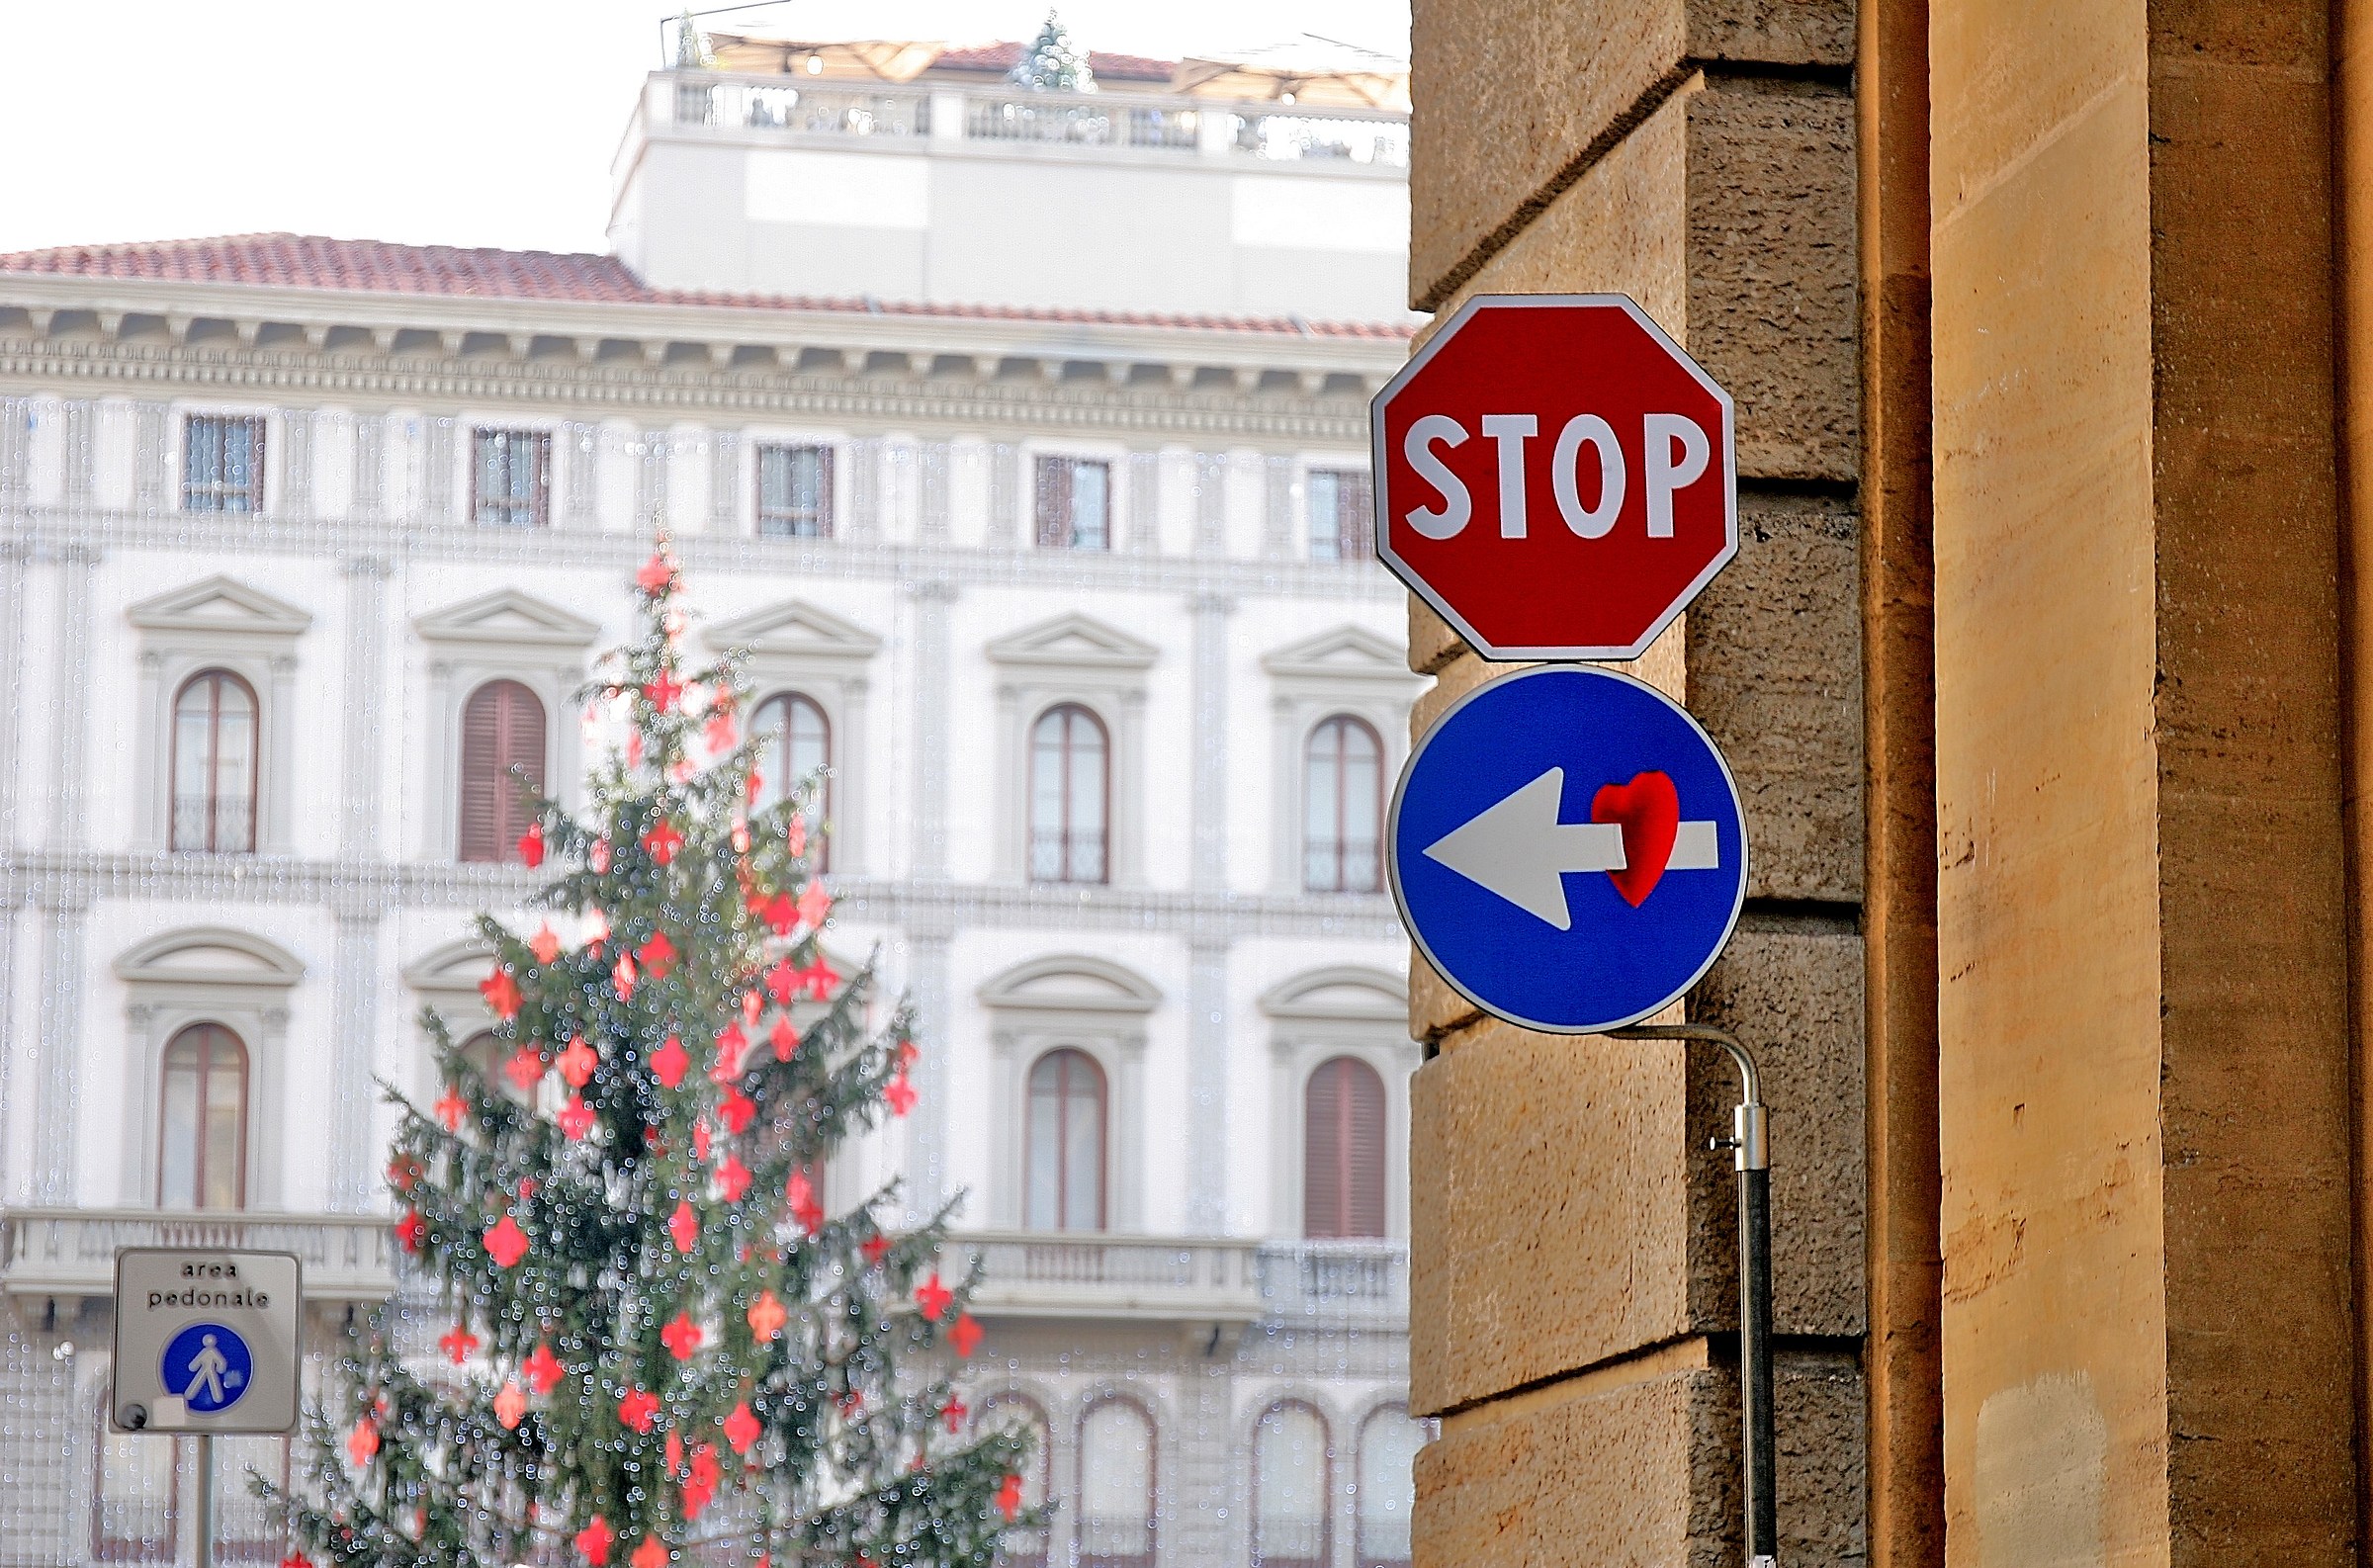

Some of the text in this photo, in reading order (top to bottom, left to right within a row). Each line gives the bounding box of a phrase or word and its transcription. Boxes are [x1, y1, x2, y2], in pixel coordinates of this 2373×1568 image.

[1404, 414, 1710, 539] STOP
[182, 1263, 236, 1277] area
[149, 1288, 269, 1309] pedonale
